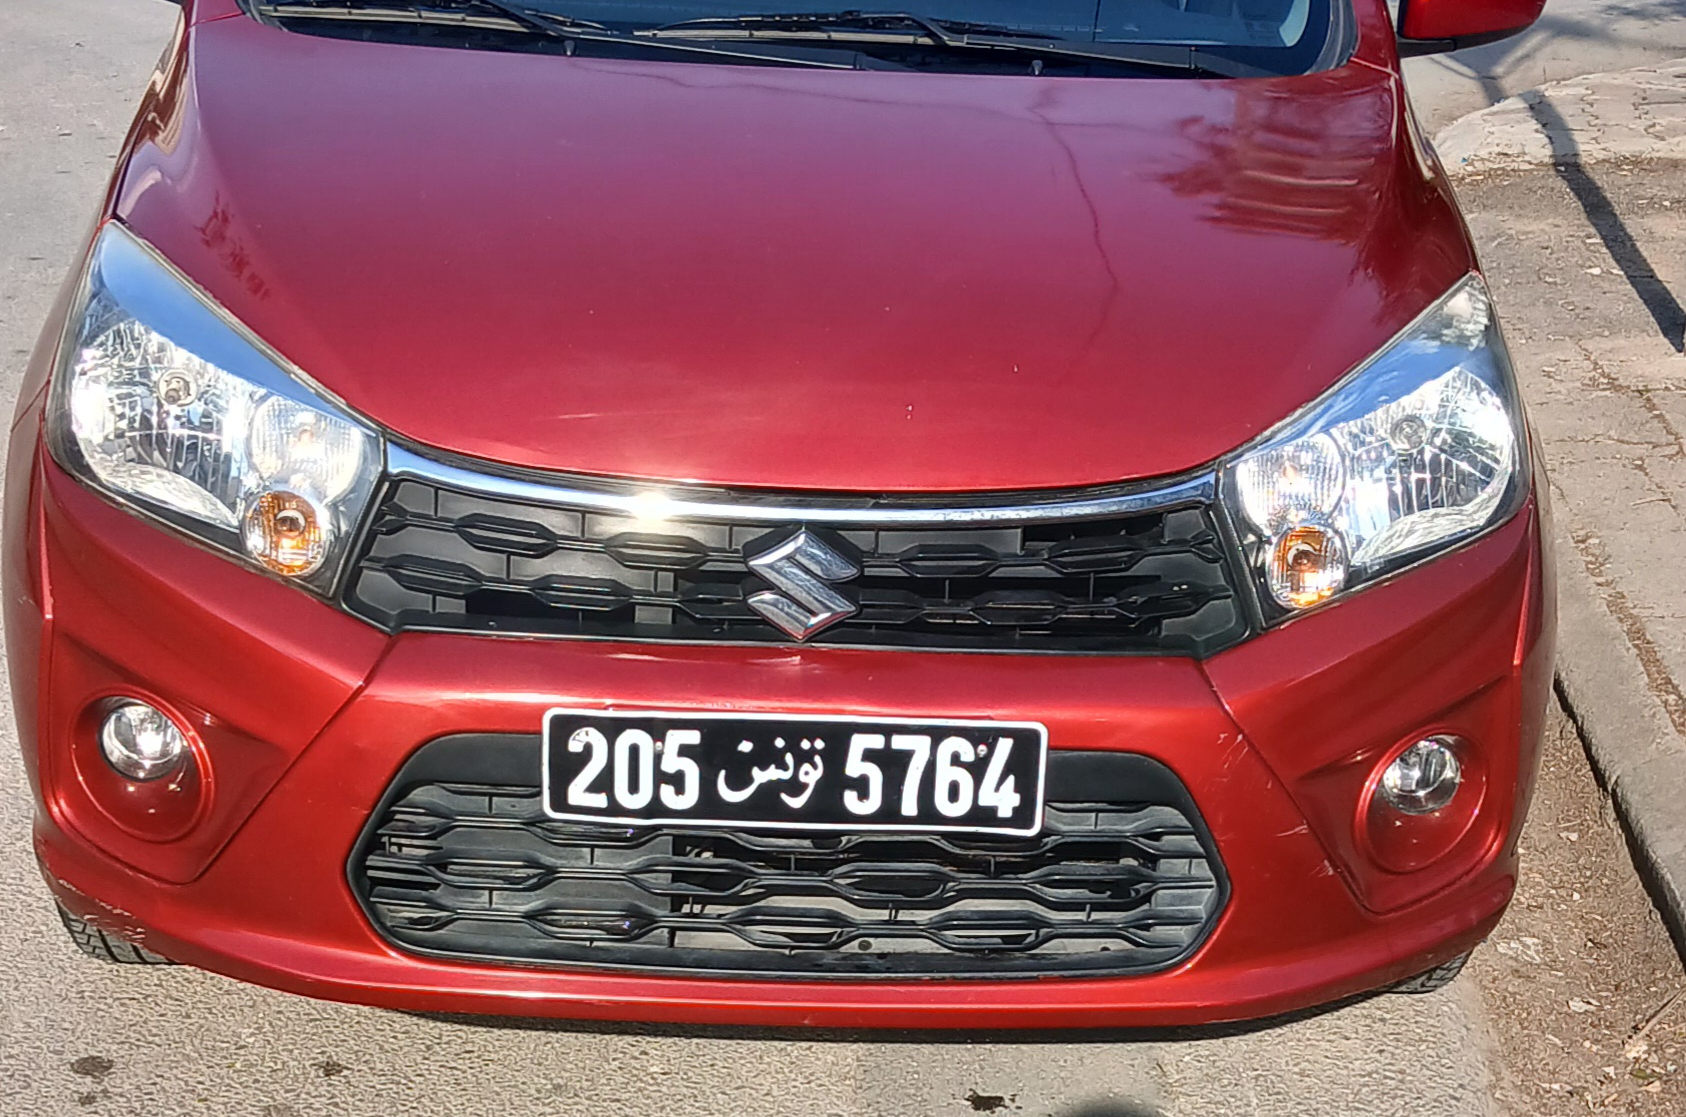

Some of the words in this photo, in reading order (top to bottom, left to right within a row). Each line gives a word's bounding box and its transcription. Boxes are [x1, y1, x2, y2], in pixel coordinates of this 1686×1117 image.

[567, 727, 702, 810] 205
[716, 737, 826, 809] تونس
[843, 732, 1021, 818] 5764
